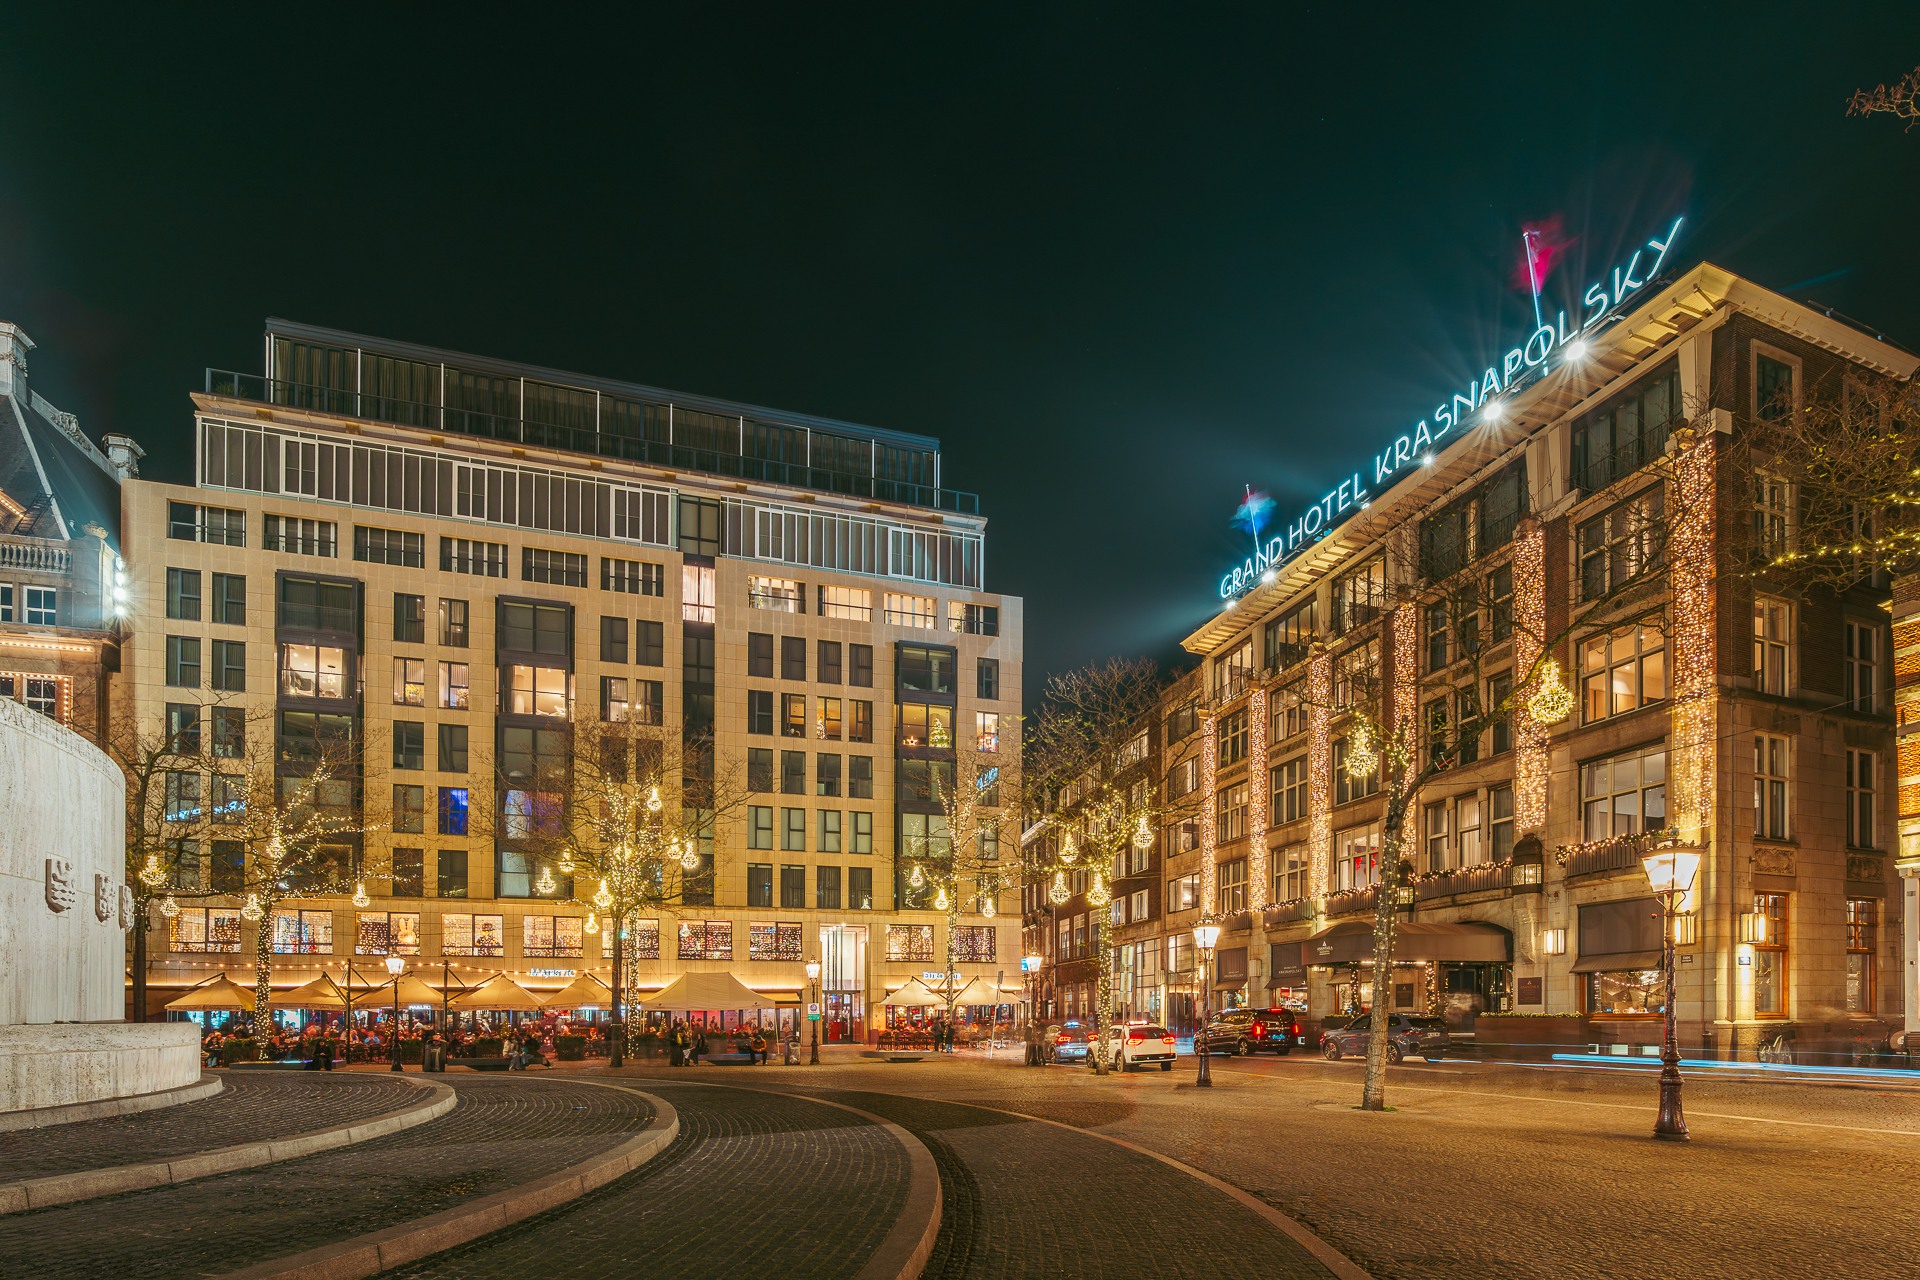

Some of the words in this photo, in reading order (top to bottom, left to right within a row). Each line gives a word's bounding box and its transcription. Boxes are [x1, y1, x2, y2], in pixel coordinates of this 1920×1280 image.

[1220, 536, 1283, 598] GRAND
[1288, 472, 1367, 550] HOTEL
[1375, 216, 1684, 485] KRASNAPOLSKY
[530, 967, 576, 978] MAJESTIC
